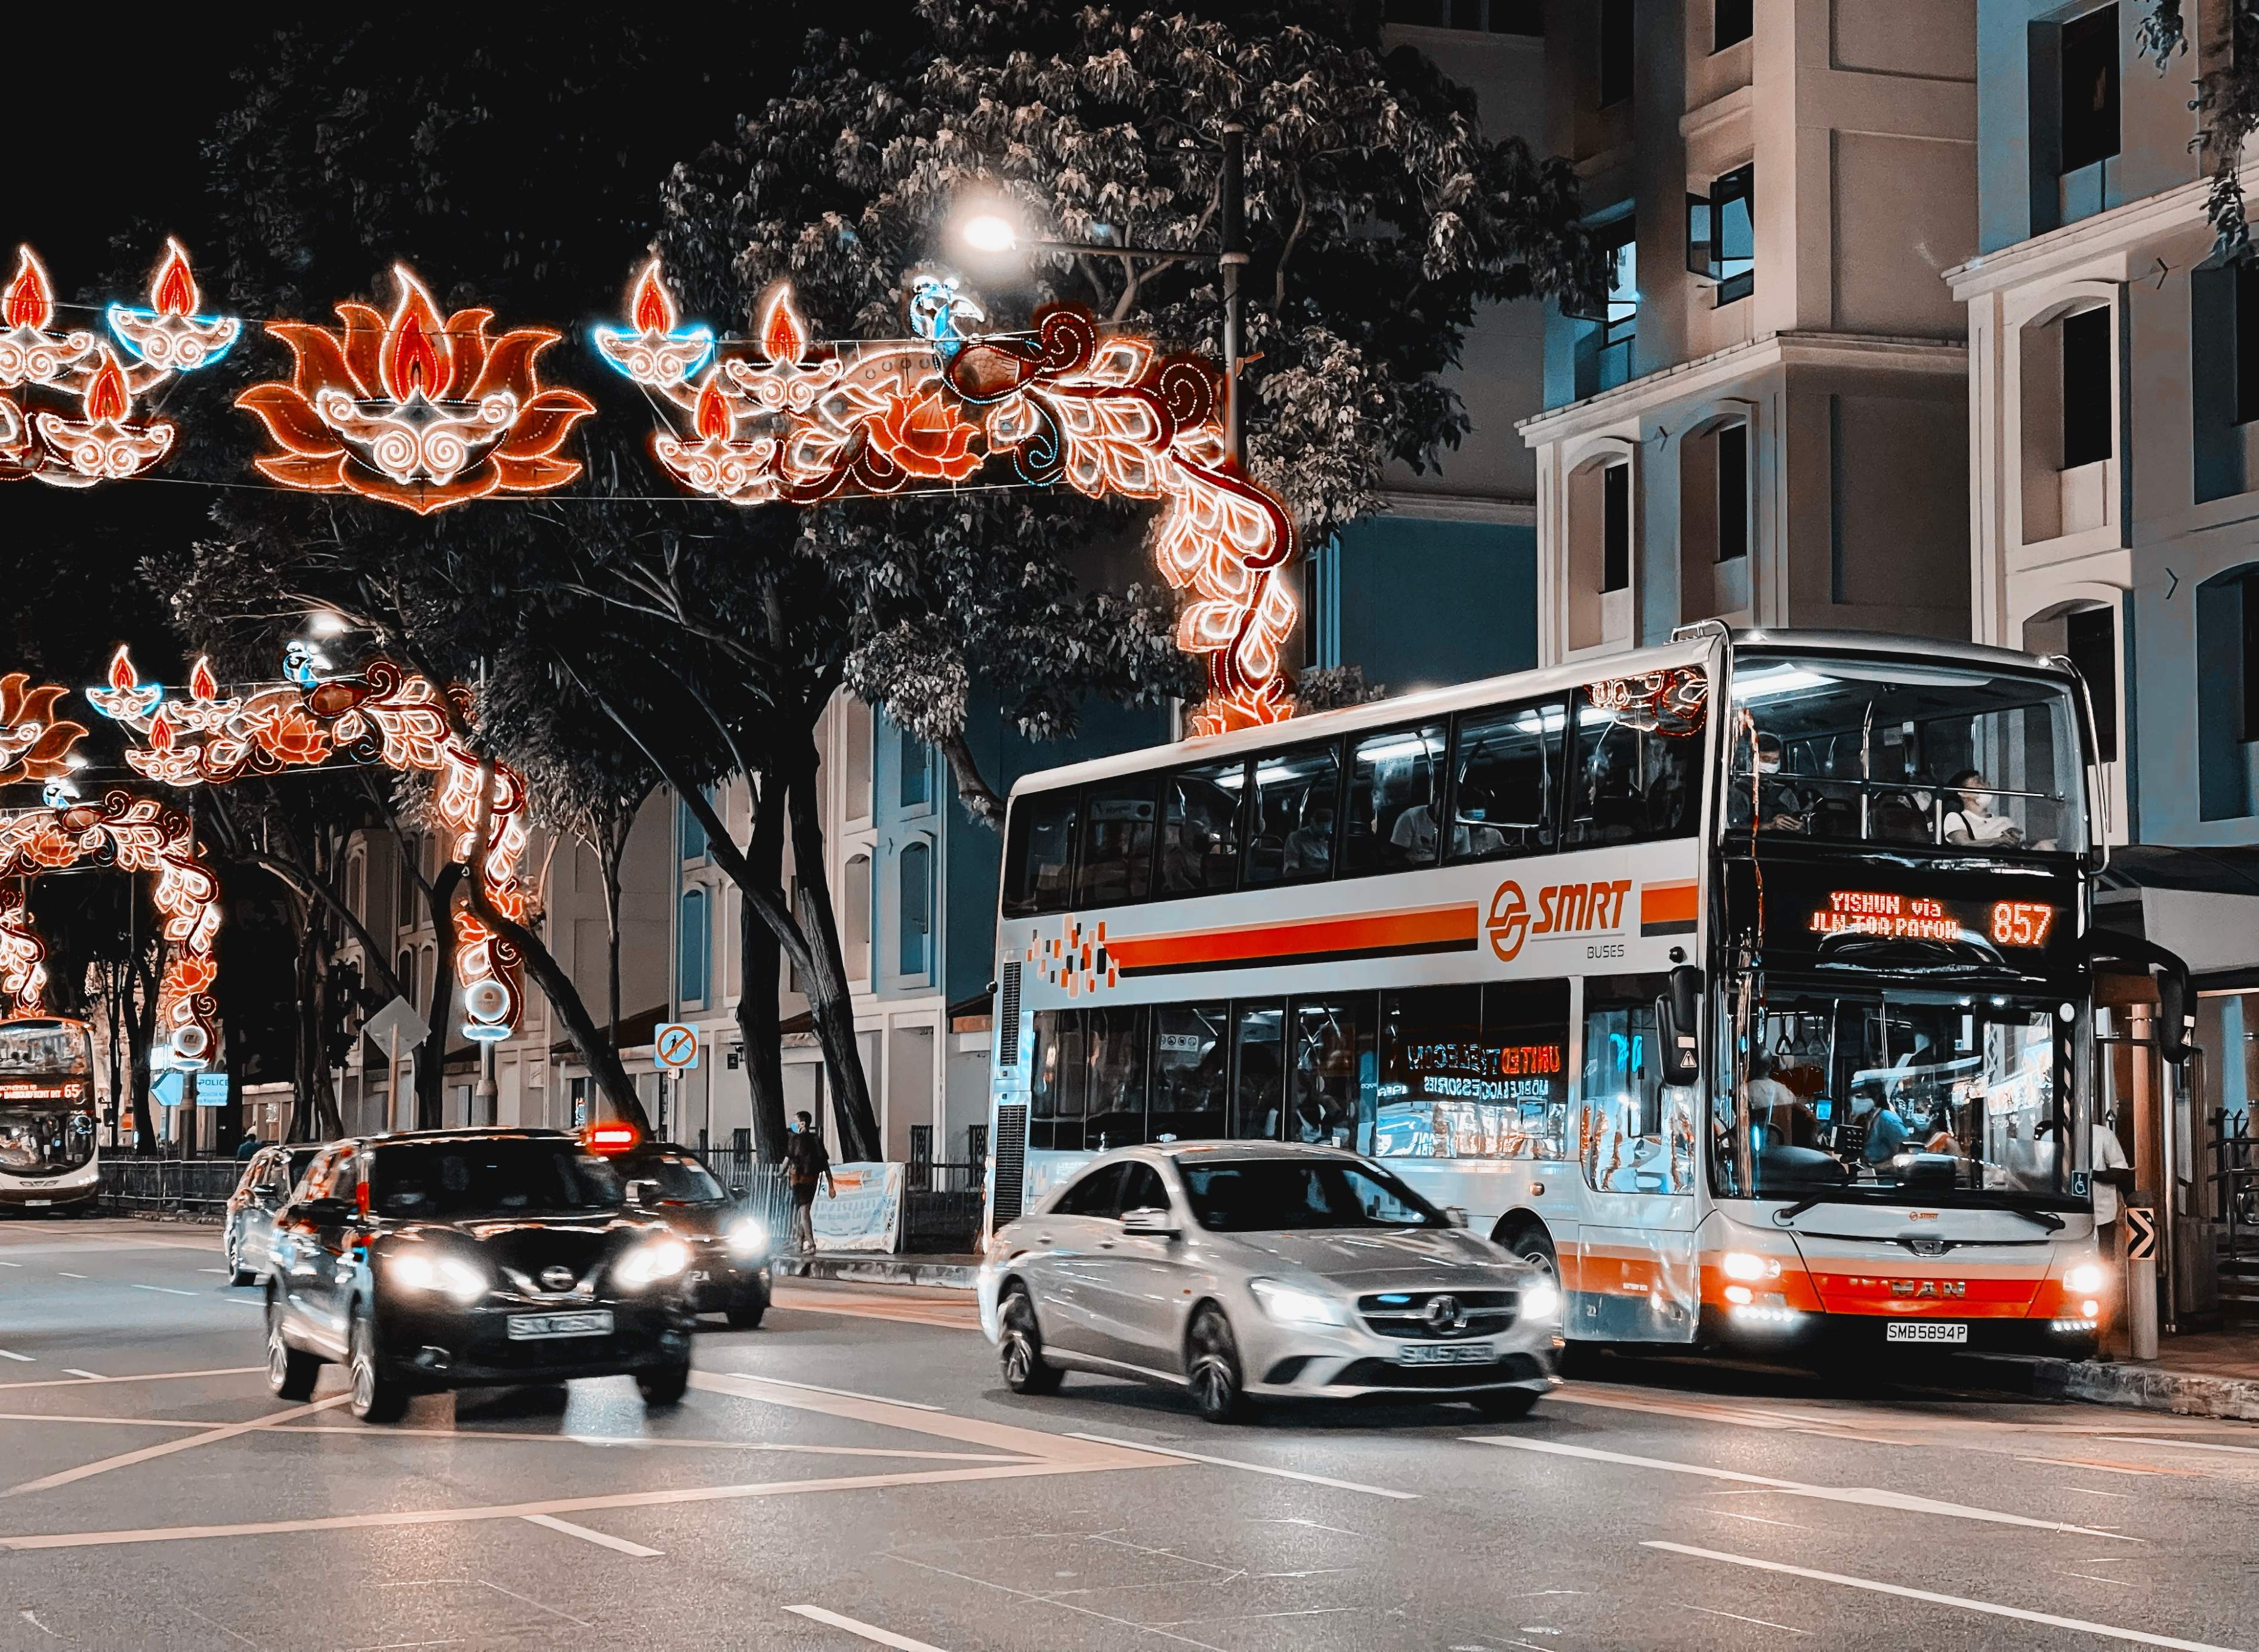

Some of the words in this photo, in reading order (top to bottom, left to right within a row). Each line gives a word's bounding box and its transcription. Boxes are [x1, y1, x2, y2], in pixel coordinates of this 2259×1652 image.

[1532, 879, 1632, 934] SMRT
[1830, 892, 1900, 915] YISHUN
[1911, 898, 1942, 918] via
[1809, 912, 1846, 932] JLN
[1851, 915, 1890, 934] TOA
[1895, 918, 1958, 940] PAYOH
[1993, 902, 2053, 945] 857
[1587, 944, 1625, 959] BUSES
[64, 1083, 81, 1098] 65
[1891, 1280, 1965, 1298] MAN
[1888, 1325, 1965, 1339] SMB5894P
